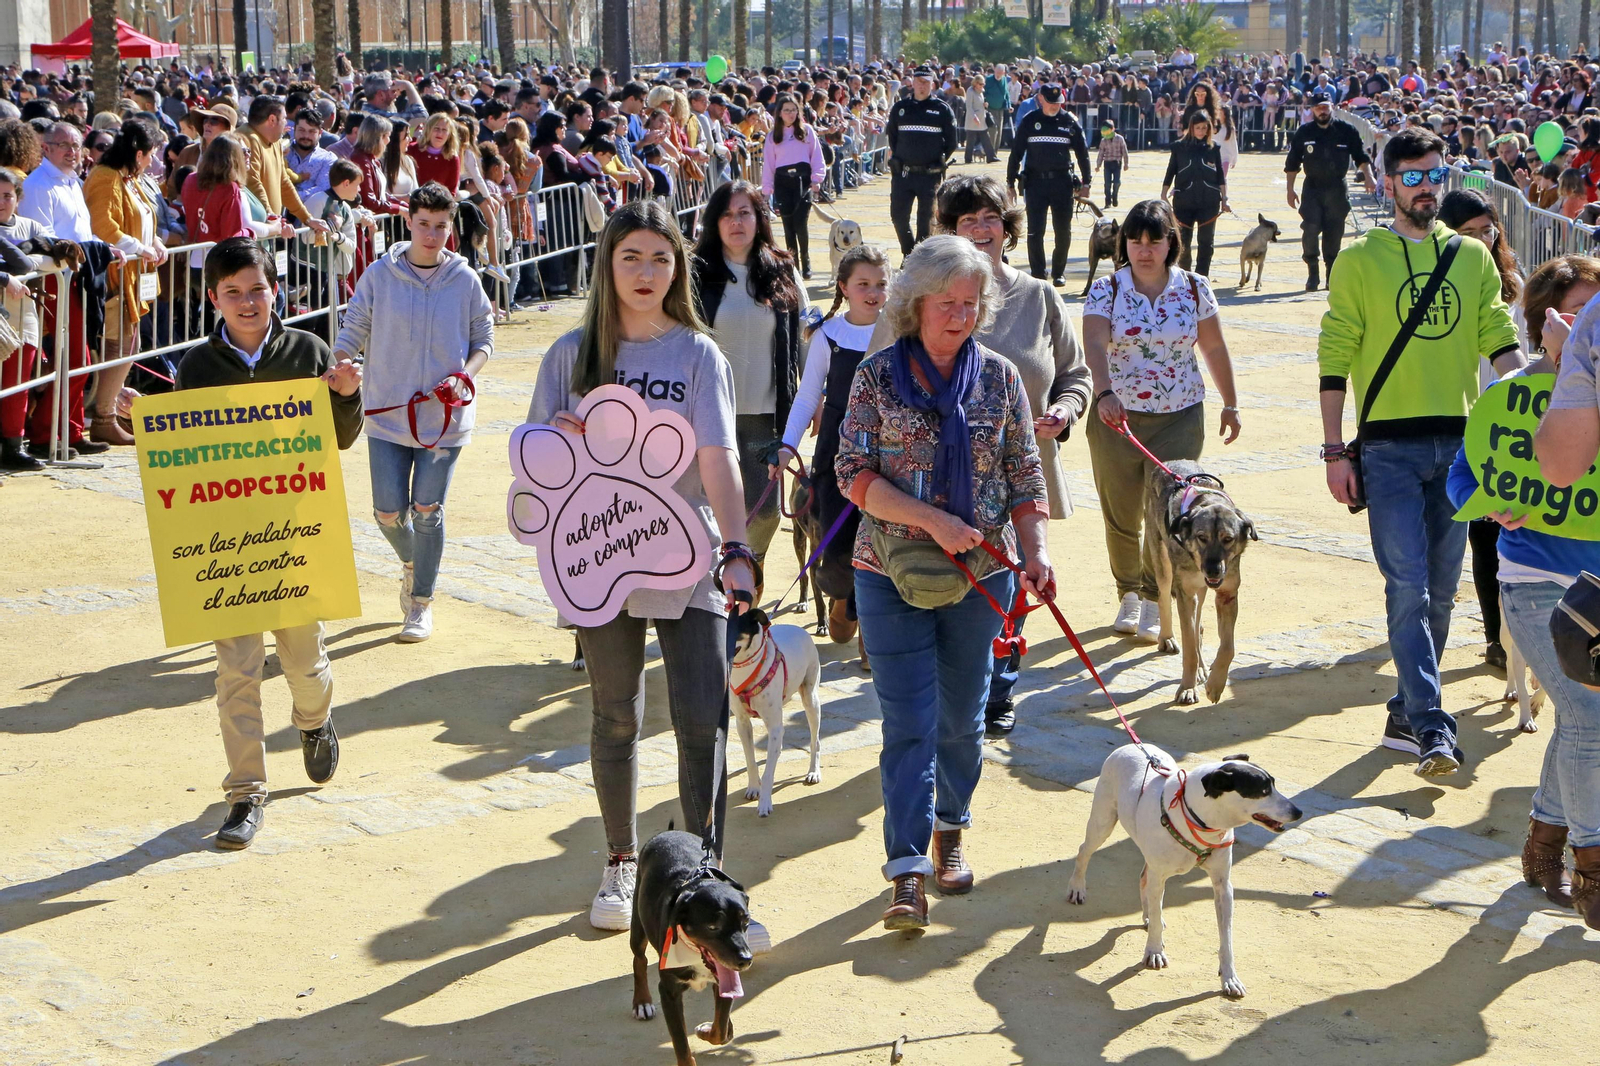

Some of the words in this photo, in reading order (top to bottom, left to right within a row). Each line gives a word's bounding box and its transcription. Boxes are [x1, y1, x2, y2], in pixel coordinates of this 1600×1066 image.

[1408, 306, 1450, 326] AIT
[1429, 305, 1439, 313] THE
[614, 369, 686, 403] idas
[1506, 382, 1552, 420] no
[143, 395, 313, 433] ESTERILIZACIÓN
[147, 429, 322, 468] IDENTIFICACIÓN
[157, 488, 176, 509] Y
[189, 462, 326, 504] ADOPCIÓN
[1480, 455, 1599, 526] tengo
[566, 492, 642, 546] adopta,
[172, 543, 205, 559] son
[209, 532, 236, 554] las
[237, 519, 322, 554] palabras
[567, 558, 589, 577] no
[594, 517, 670, 566] compres
[195, 559, 245, 582] clave
[248, 550, 307, 574] contra
[203, 587, 223, 611] el
[224, 579, 310, 608] abandono
